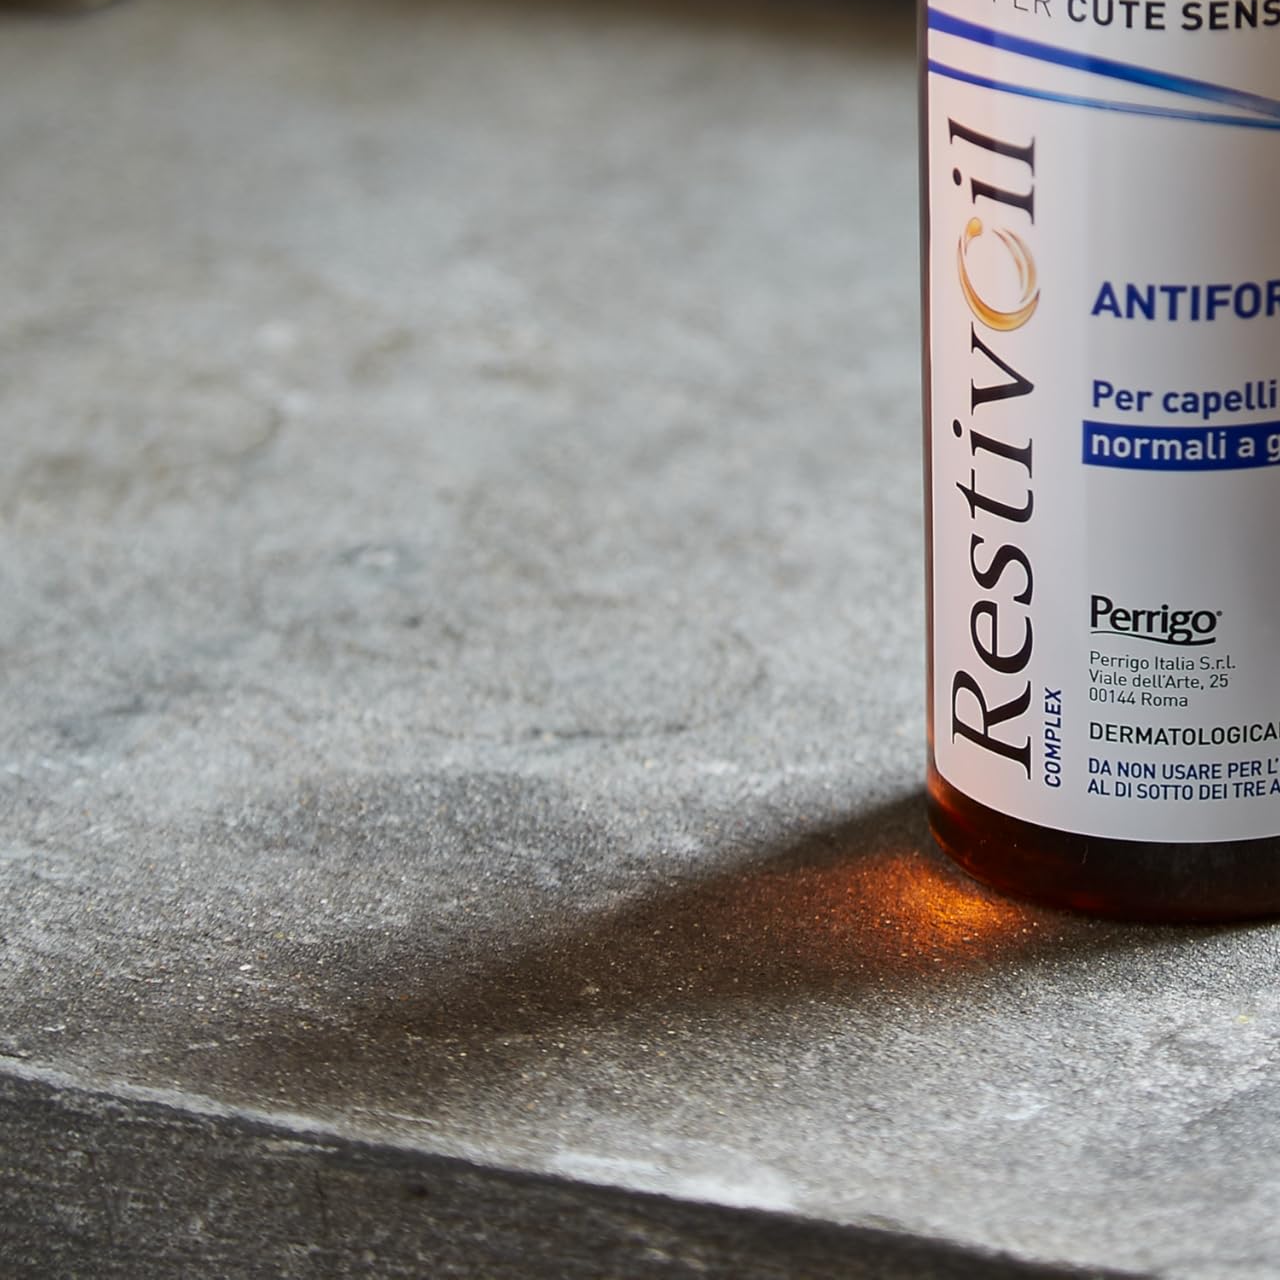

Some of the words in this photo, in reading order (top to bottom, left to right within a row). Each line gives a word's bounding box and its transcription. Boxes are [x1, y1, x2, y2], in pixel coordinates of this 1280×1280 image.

[1092, 379, 1154, 412] Per
[1162, 380, 1277, 420] capelli
[1091, 431, 1227, 462] normali
[1237, 436, 1256, 457] a
[1090, 594, 1218, 644] Perrigo
[1089, 650, 1150, 673] Perrigo
[1154, 655, 1195, 671] Italia
[1199, 654, 1237, 671] S.r.l.
[1088, 668, 1128, 686] Viale
[1132, 674, 1205, 691] dell'Arte,
[1209, 673, 1229, 688] 25
[1089, 687, 1137, 705] 00144
[1141, 692, 1189, 708] Roma
[1044, 687, 1064, 789] COMPLEX
[1088, 758, 1112, 777] DA
[1117, 761, 1156, 780] NON
[1162, 761, 1221, 781] USARE
[1227, 760, 1262, 779] PER
[1087, 778, 1111, 797] AL
[1115, 781, 1134, 800] DI
[1137, 783, 1194, 801] SOTTO
[1199, 783, 1229, 801] DEI
[1232, 779, 1267, 799] TRE
